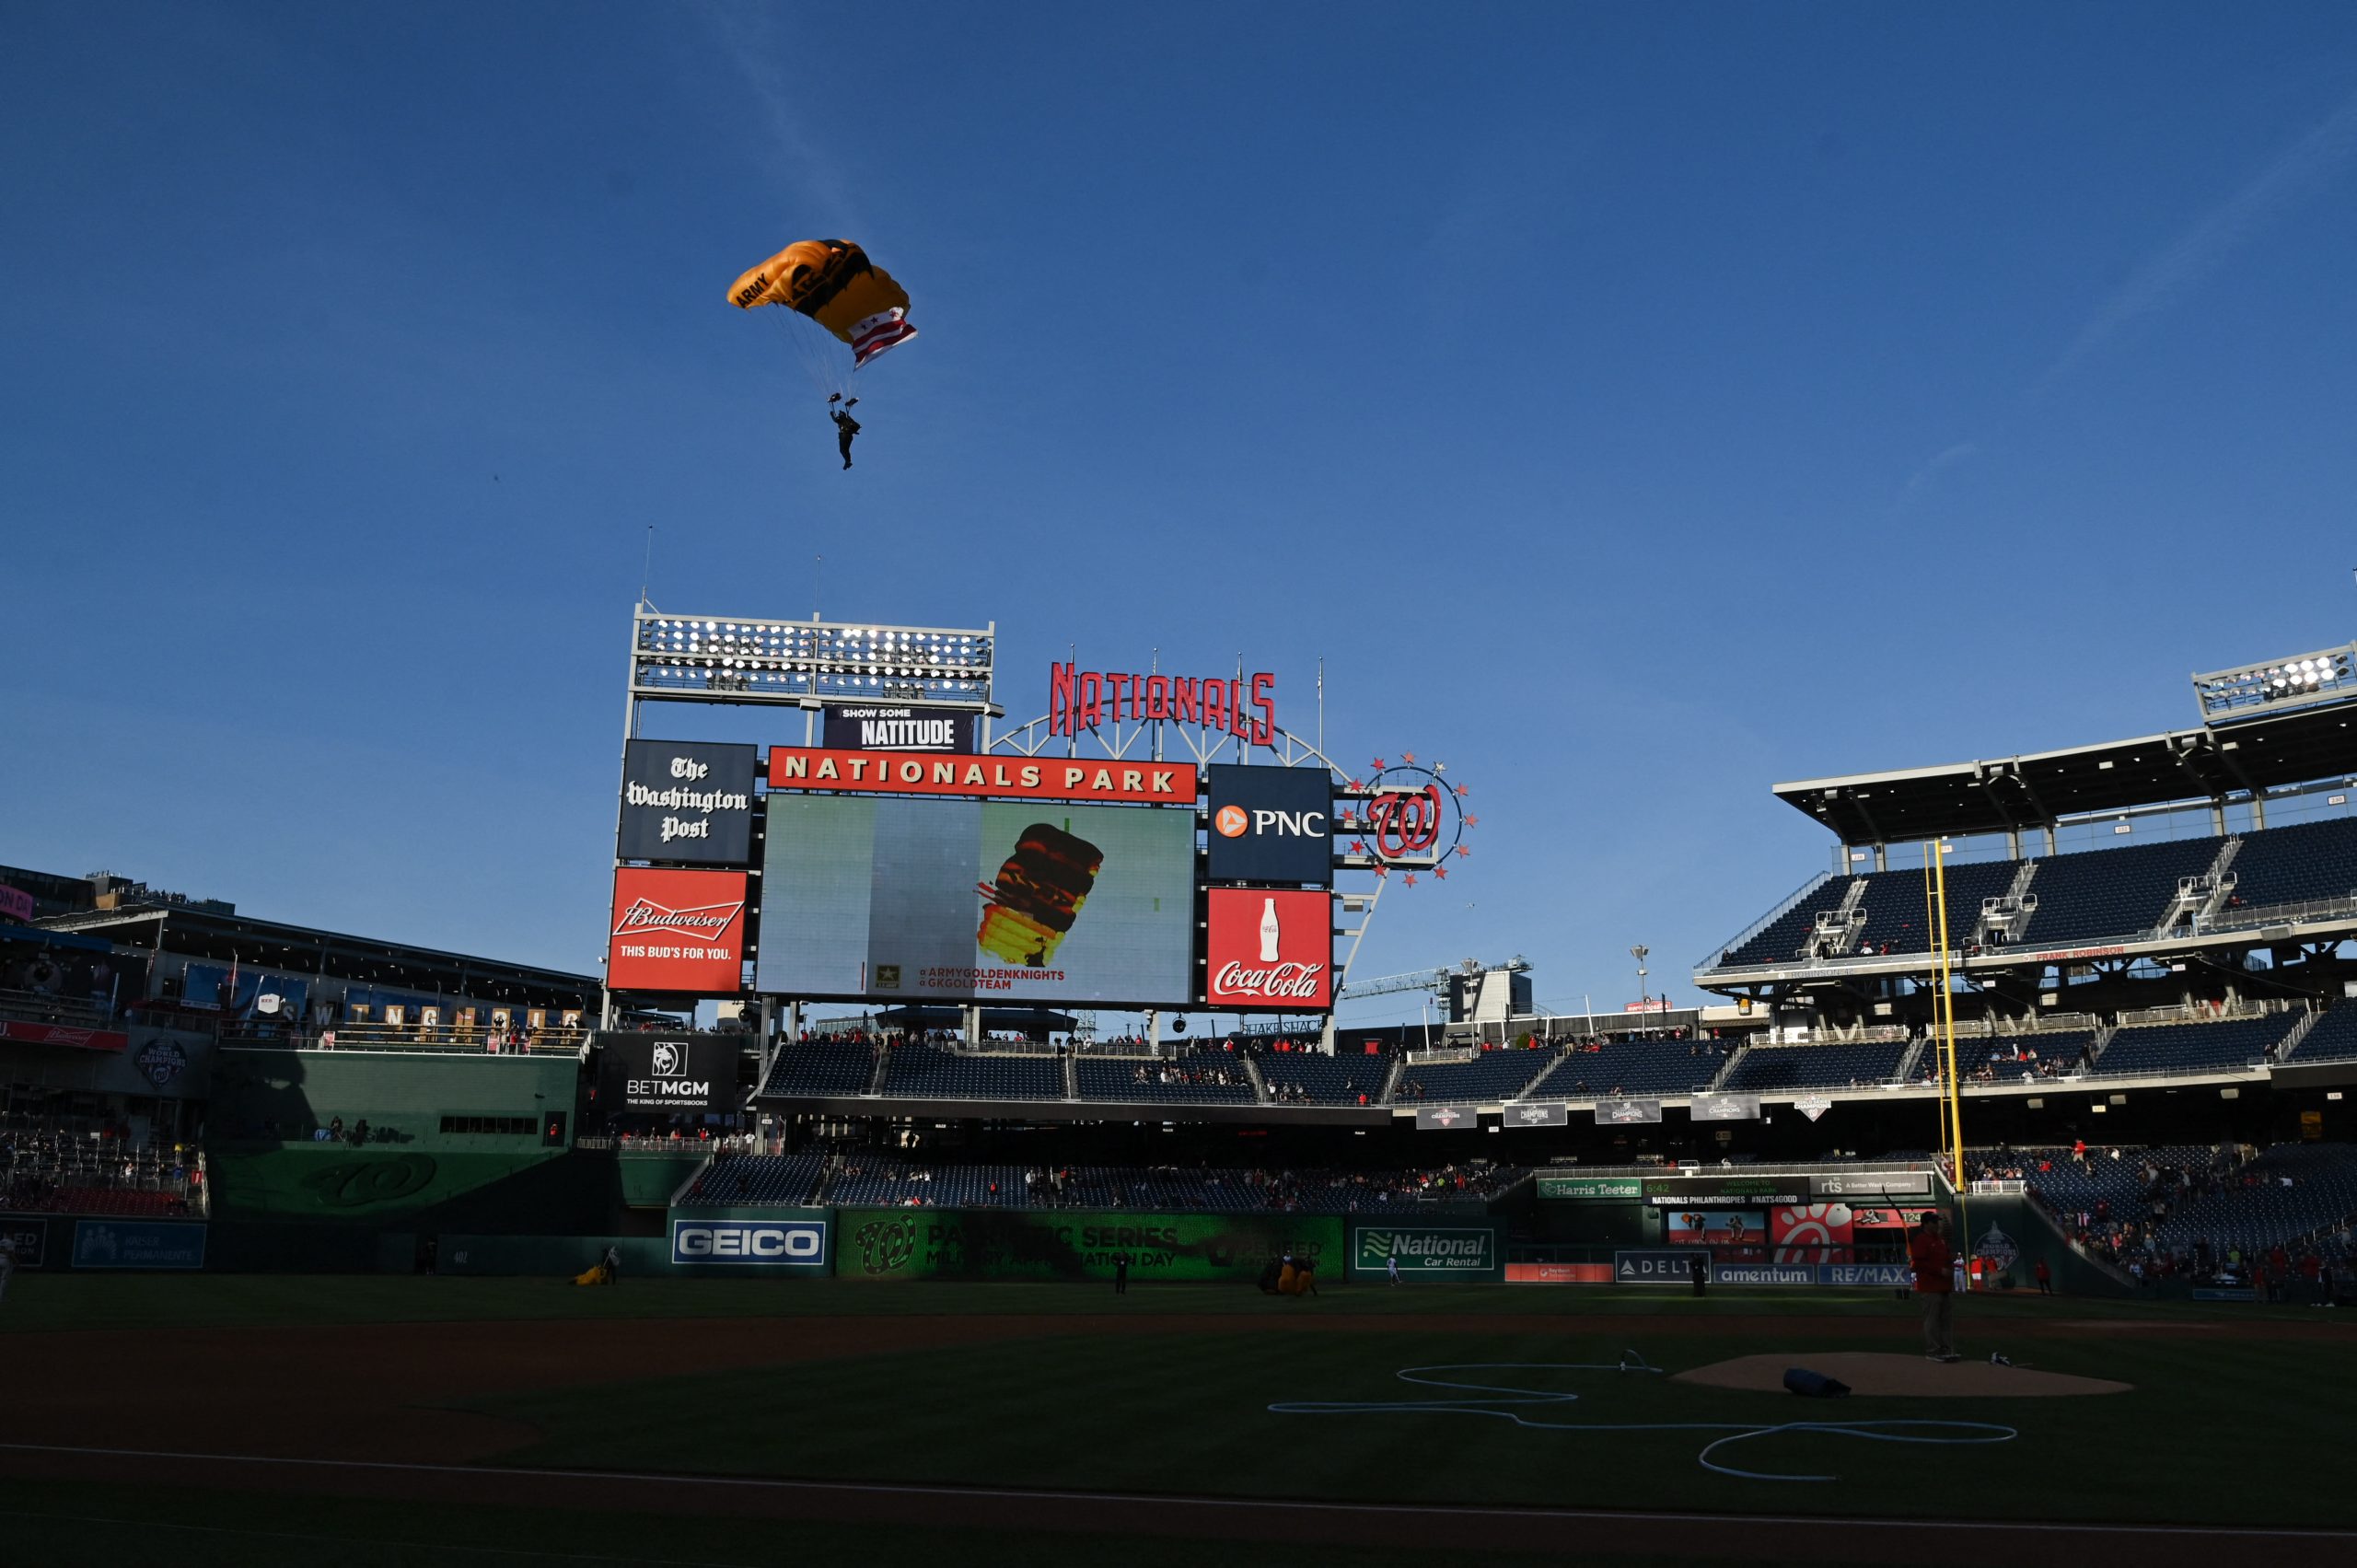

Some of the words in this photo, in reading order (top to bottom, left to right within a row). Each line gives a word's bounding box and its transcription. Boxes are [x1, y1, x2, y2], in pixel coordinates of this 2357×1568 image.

[736, 273, 770, 308] ARMY
[1050, 661, 1275, 746] NATIONALS
[842, 709, 877, 718] SHOW
[879, 709, 911, 718] SOME
[862, 720, 954, 746] NATITUDE
[670, 757, 709, 782] The
[785, 756, 1040, 789] NATIONALS
[1065, 768, 1175, 793] PARK
[626, 781, 749, 813] Washington
[660, 816, 711, 842] Post
[1252, 809, 1325, 839] PNC
[625, 905, 728, 928] Budweiser
[621, 946, 644, 958] THIS
[647, 946, 679, 958] BUD'S
[683, 947, 704, 958] FOR
[707, 947, 732, 959] YOU.
[2037, 951, 2068, 961] FRANK
[2073, 947, 2124, 958] ROBINSON
[1213, 960, 1324, 998] Coca-Cola
[1791, 969, 1840, 978] ROBINSON
[149, 1048, 180, 1058] WORLD
[140, 1055, 185, 1068] CHAMPIONS
[627, 1080, 709, 1096] BETMGM
[1520, 1109, 1549, 1120] CHAMPIONS
[1556, 1184, 1596, 1195] Harris
[1598, 1183, 1638, 1195] Teeter
[1646, 1184, 1670, 1193] 6:42
[1821, 1179, 1842, 1193] rts
[1652, 1196, 1689, 1204] NATIONALS
[1689, 1195, 1746, 1204] PHILANTHROPIES
[1751, 1195, 1798, 1203] #NATS4GOOD
[124, 1236, 161, 1247] KAISER
[679, 1228, 819, 1257] GEICO
[1082, 1226, 1178, 1248] SERIES
[1391, 1234, 1485, 1255] National
[122, 1249, 192, 1260] PERMANENTE
[1141, 1252, 1177, 1267] DAY
[1424, 1258, 1442, 1267] Car
[1446, 1257, 1480, 1267] Rental
[1721, 1267, 1807, 1282] amentum
[1831, 1268, 1906, 1282] RE/MAX
